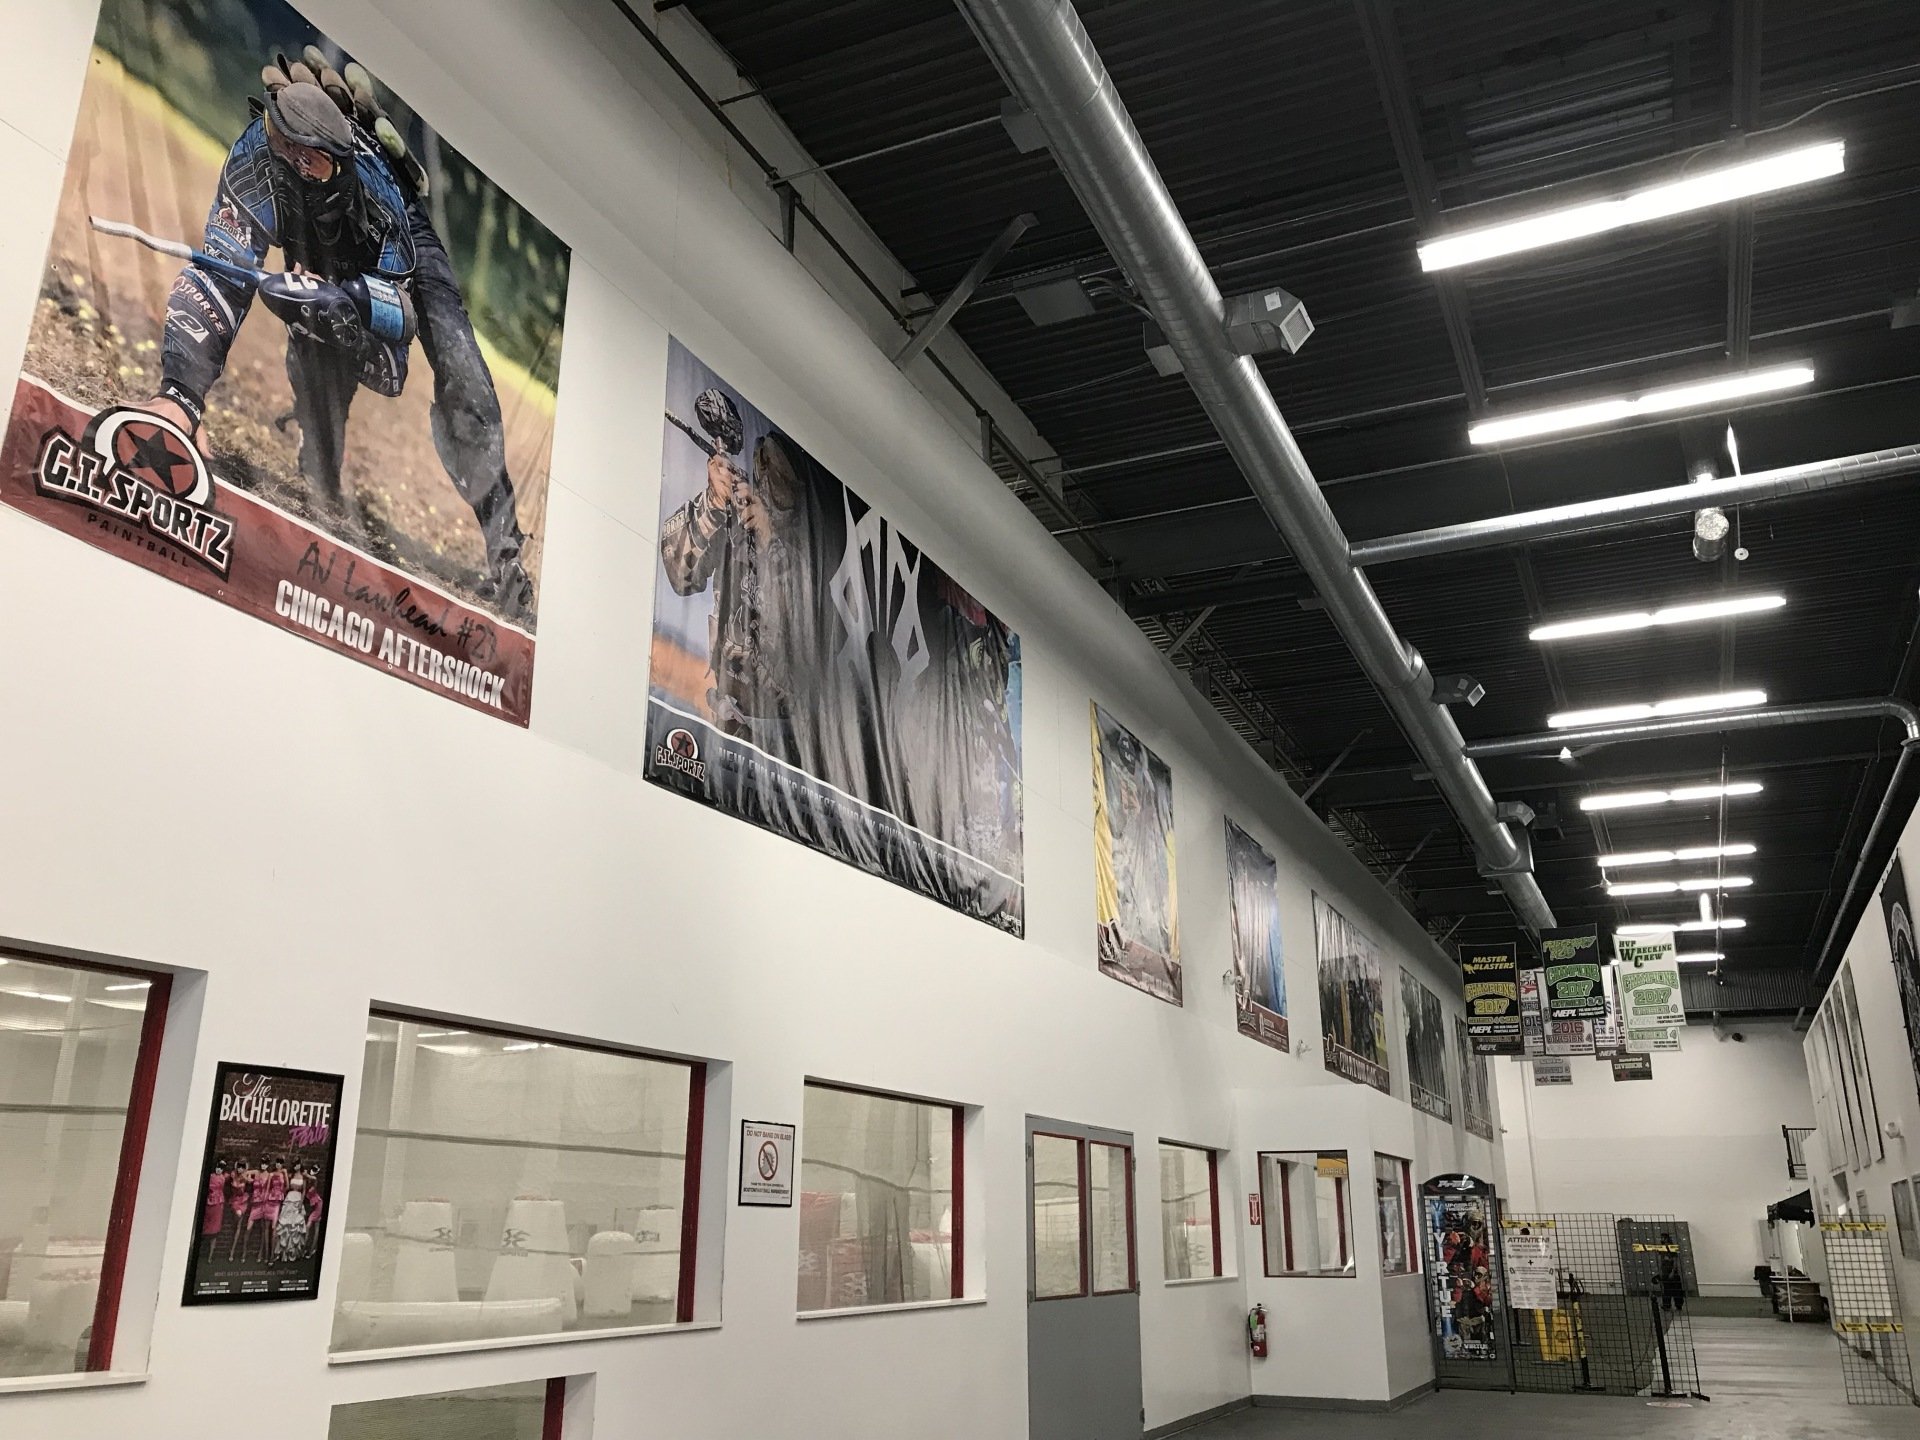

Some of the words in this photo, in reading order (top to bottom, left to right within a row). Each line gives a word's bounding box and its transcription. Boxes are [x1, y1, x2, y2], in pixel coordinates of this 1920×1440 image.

[104, 469, 235, 574] SPORTZ
[87, 512, 190, 568] PAINTBALL
[275, 580, 374, 653] CHICAGO
[378, 629, 506, 710] AFTERSHOCK
[672, 752, 706, 782] SPORTZ
[1620, 943, 1672, 961] WRECKING
[1634, 953, 1663, 968] CREW
[1473, 962, 1514, 970] BLASTERS
[1547, 964, 1600, 986] CHAMPIONS
[1556, 980, 1593, 998] 2017
[1622, 970, 1679, 993] CHAMPIONS
[1465, 982, 1517, 1002] CHAMPIONS
[1633, 987, 1671, 1006] 2017
[1474, 998, 1509, 1015] 2017
[1553, 1009, 1576, 1017] NEPL
[1632, 1005, 1670, 1016] DIVISION
[1552, 1021, 1584, 1033] 2016
[1546, 1034, 1584, 1044] DIVISION
[233, 1073, 272, 1098] The
[220, 1094, 332, 1128] BACHELORETTE
[288, 1123, 329, 1147] Party
[1434, 1232, 1453, 1318] VIRTUE
